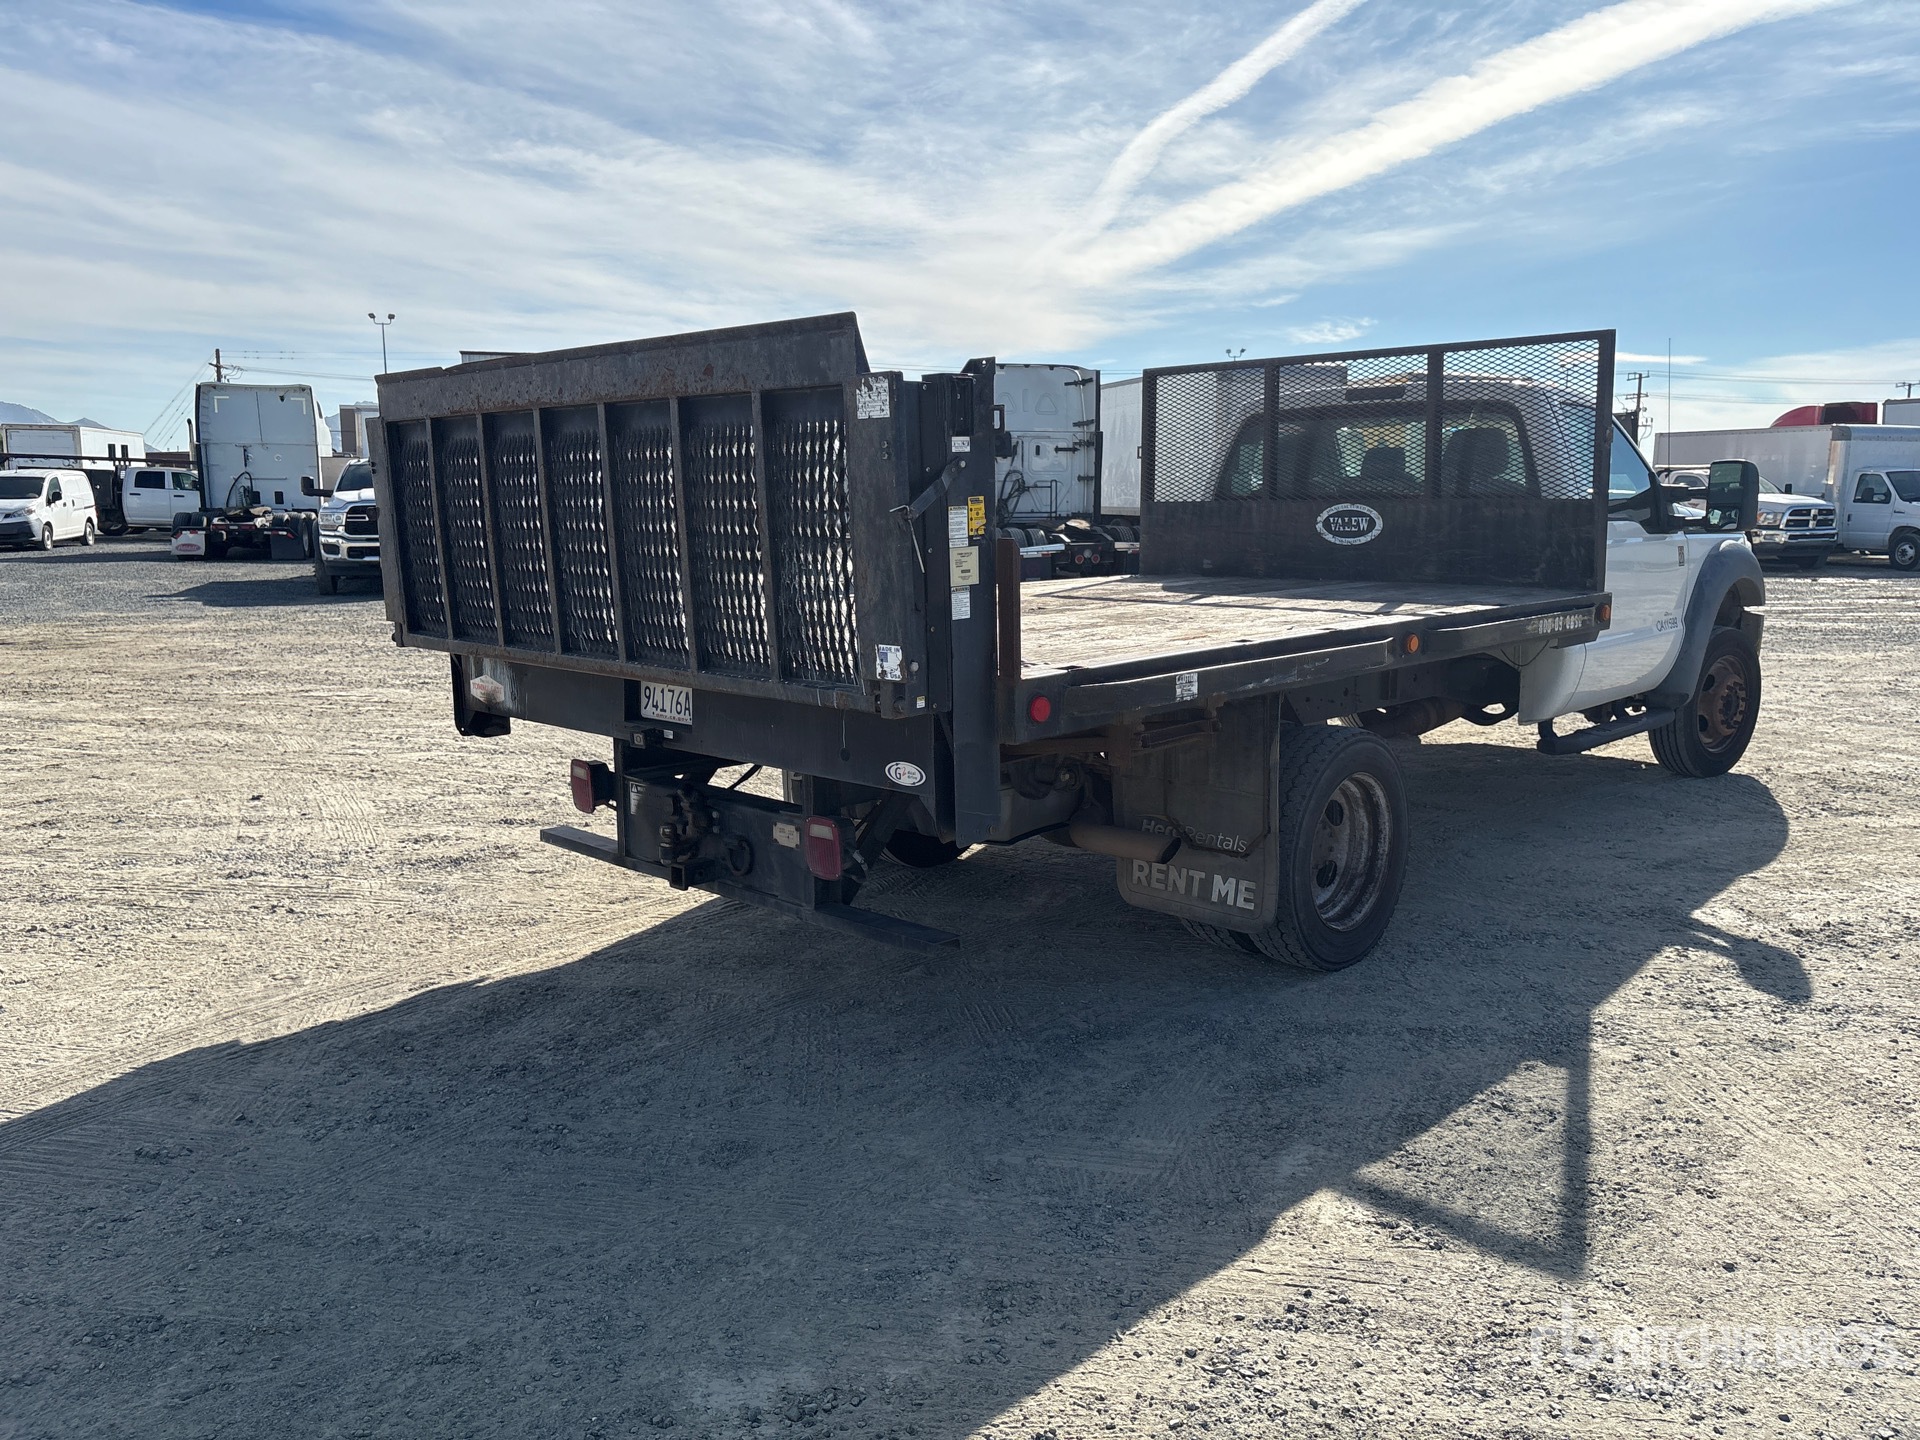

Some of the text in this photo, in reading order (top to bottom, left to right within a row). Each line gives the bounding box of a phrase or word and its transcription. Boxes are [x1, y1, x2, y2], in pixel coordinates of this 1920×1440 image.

[1328, 516, 1370, 532] VALEW
[644, 685, 692, 717] 94176A
[1132, 858, 1257, 911] RENT ME
